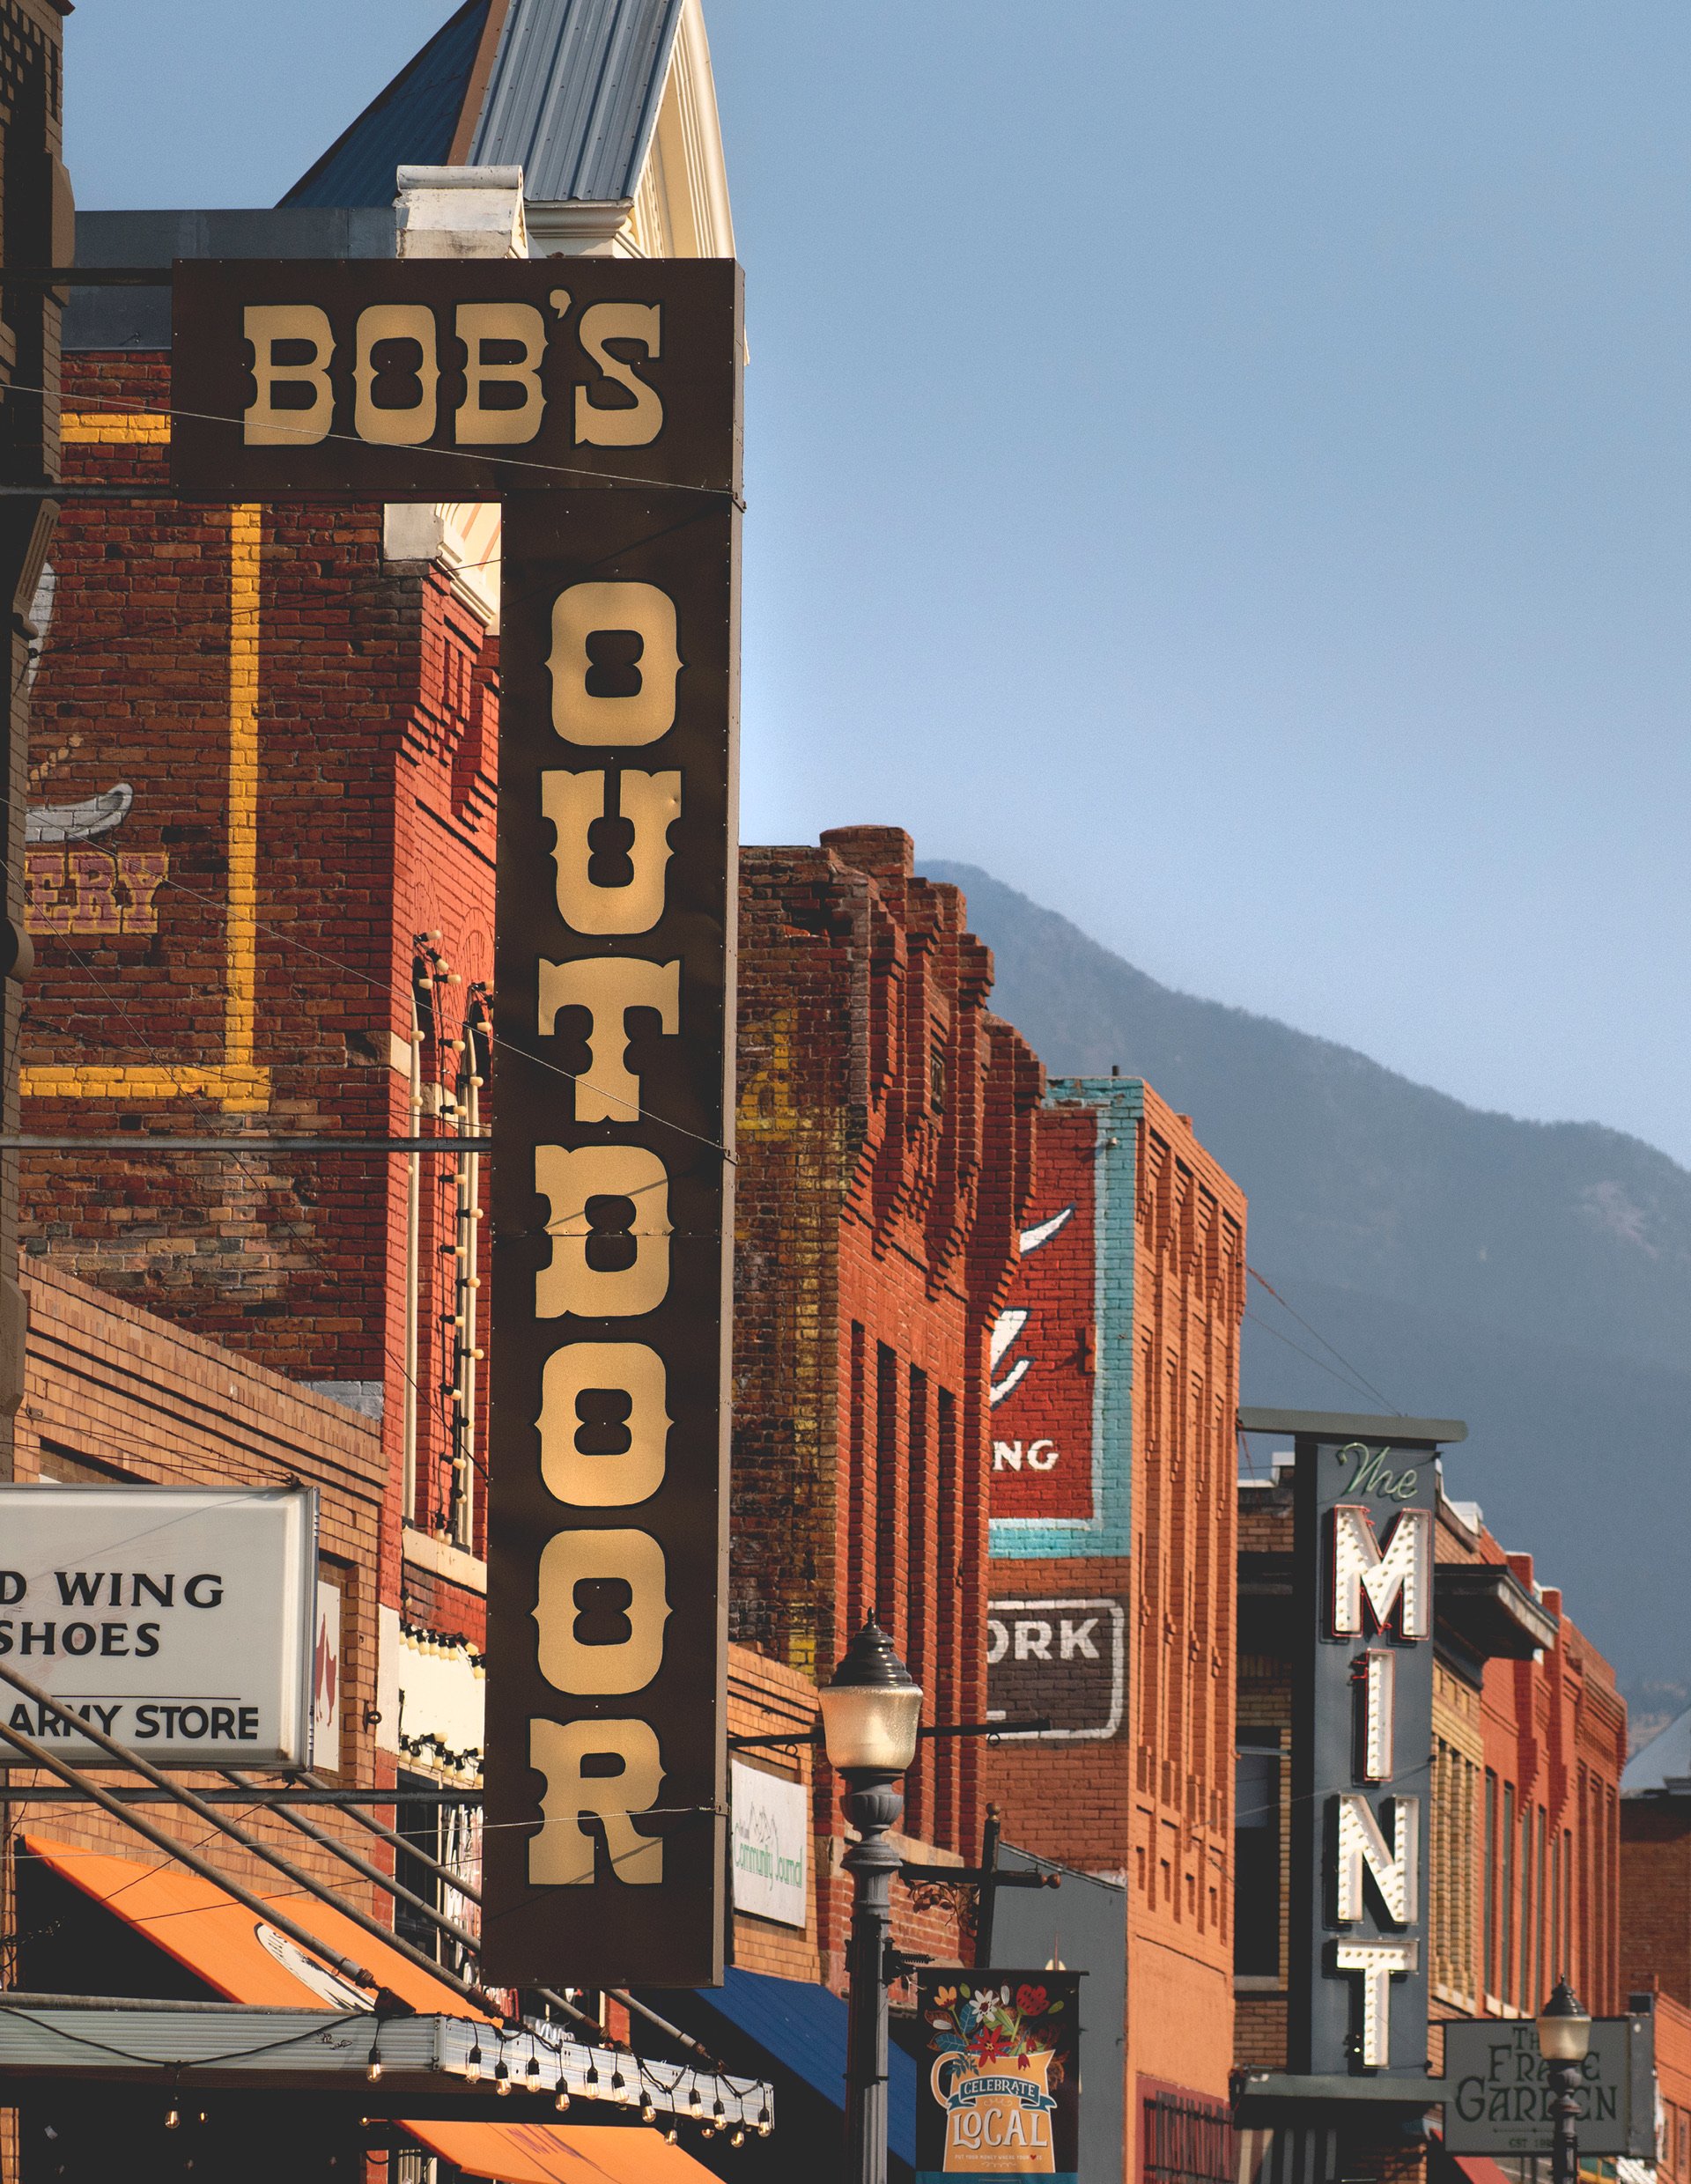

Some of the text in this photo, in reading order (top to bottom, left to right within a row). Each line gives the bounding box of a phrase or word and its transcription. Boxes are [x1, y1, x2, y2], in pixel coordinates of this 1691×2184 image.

[243, 289, 663, 446] BOB'S
[528, 581, 690, 1885] OUTDOOR
[1336, 1442, 1418, 1499] The
[54, 1571, 224, 1609] WING
[0, 1620, 160, 1657] SHOES
[135, 1704, 259, 1740] STORE
[1332, 1504, 1431, 2069] MINT
[964, 2078, 1036, 2098] CELEBRATE
[952, 2108, 1048, 2150] LOCAL
